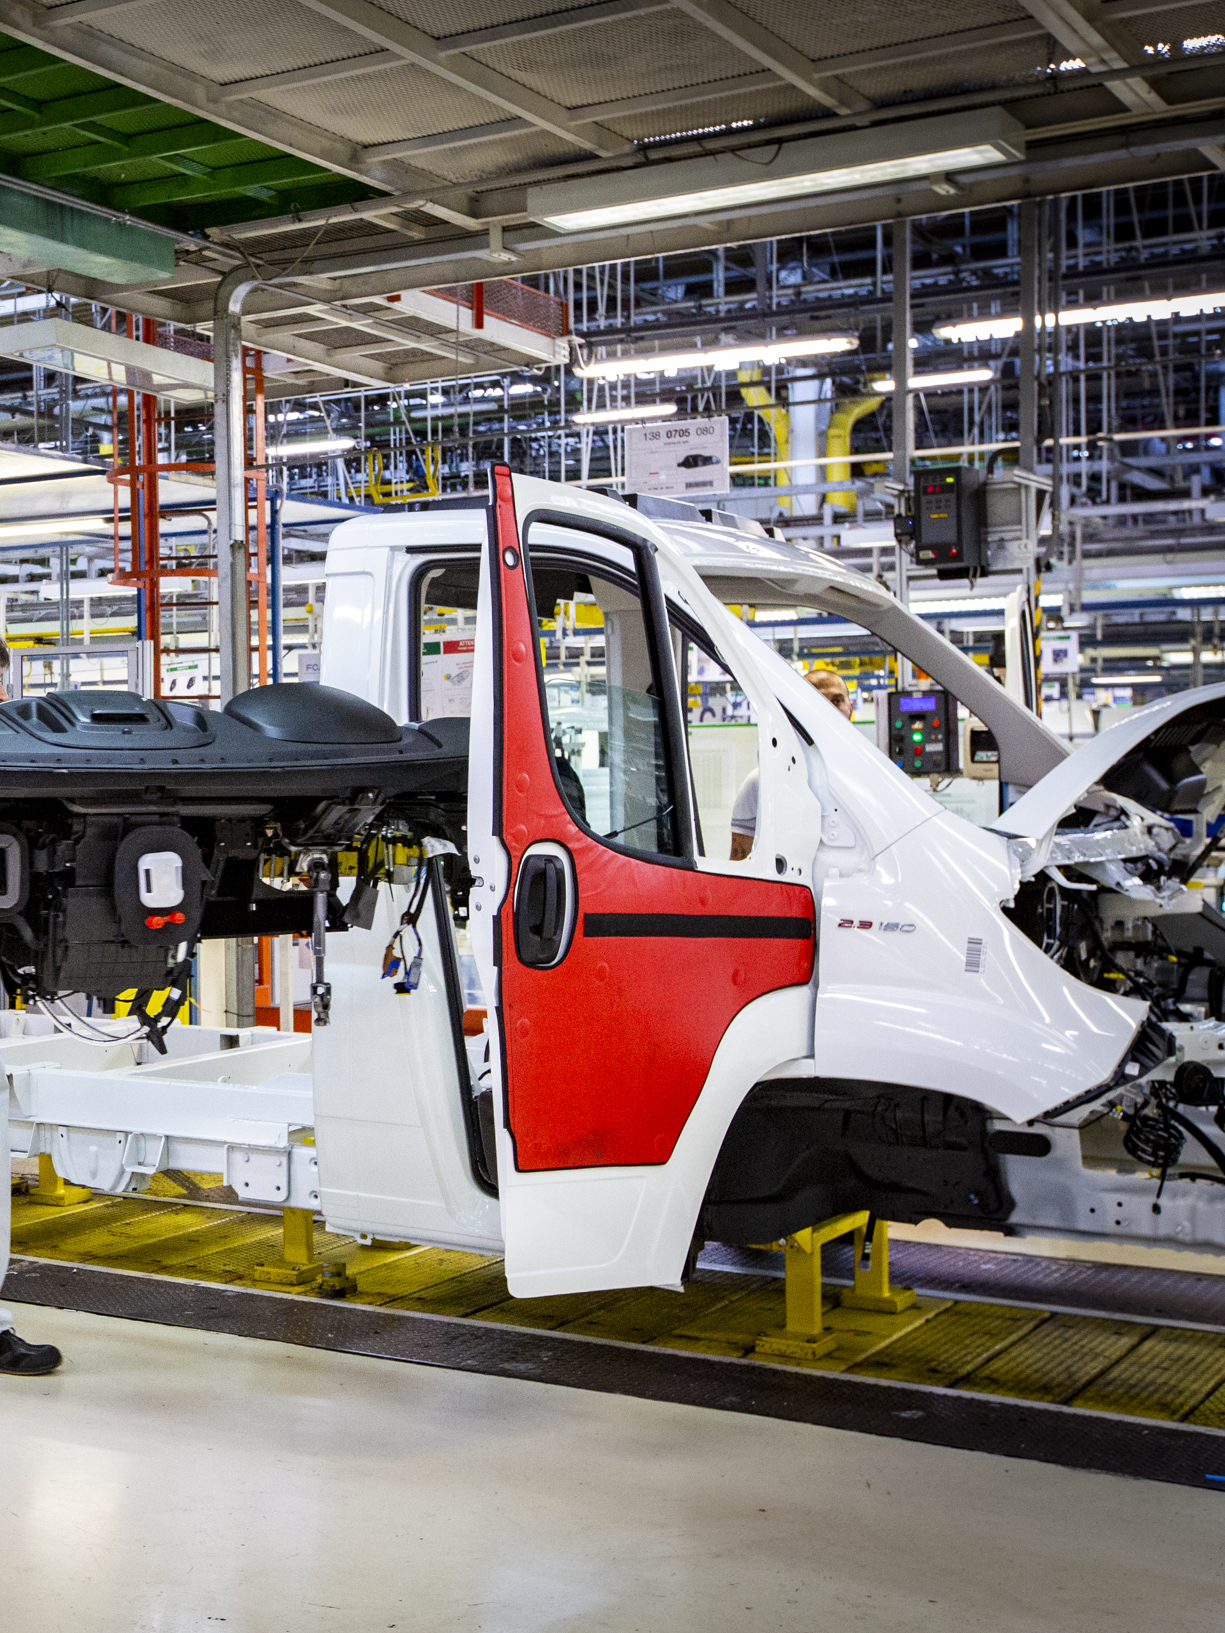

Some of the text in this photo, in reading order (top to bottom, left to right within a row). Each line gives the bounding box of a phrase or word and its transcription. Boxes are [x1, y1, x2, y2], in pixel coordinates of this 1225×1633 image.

[643, 425, 715, 441] 138 0705 080
[306, 663, 320, 672] FC
[837, 918, 874, 930] 2.3
